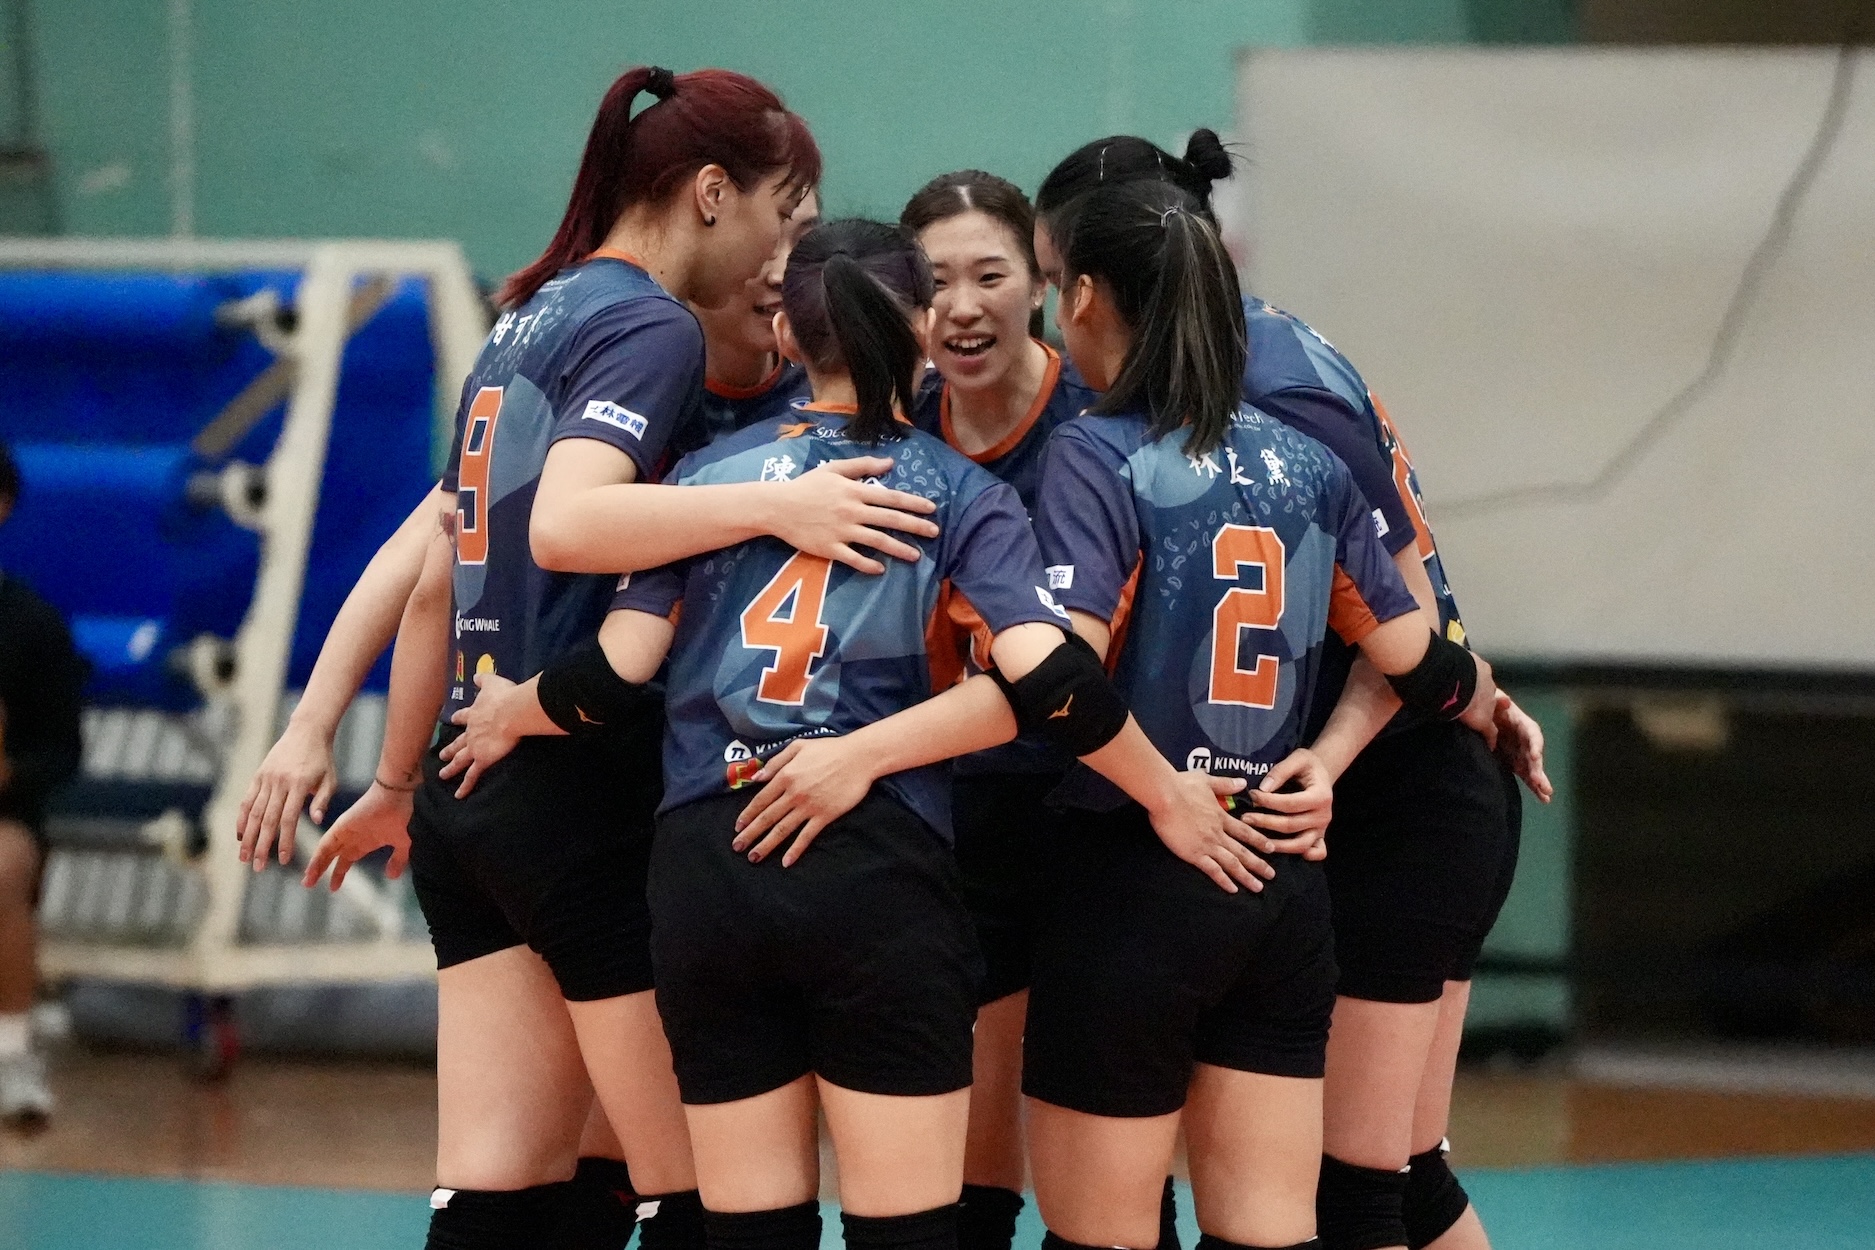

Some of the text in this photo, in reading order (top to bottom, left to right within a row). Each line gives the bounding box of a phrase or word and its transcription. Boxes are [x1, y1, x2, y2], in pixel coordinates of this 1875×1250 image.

[456, 386, 504, 566] 9
[740, 549, 833, 706] 4
[1208, 523, 1285, 710] 2
